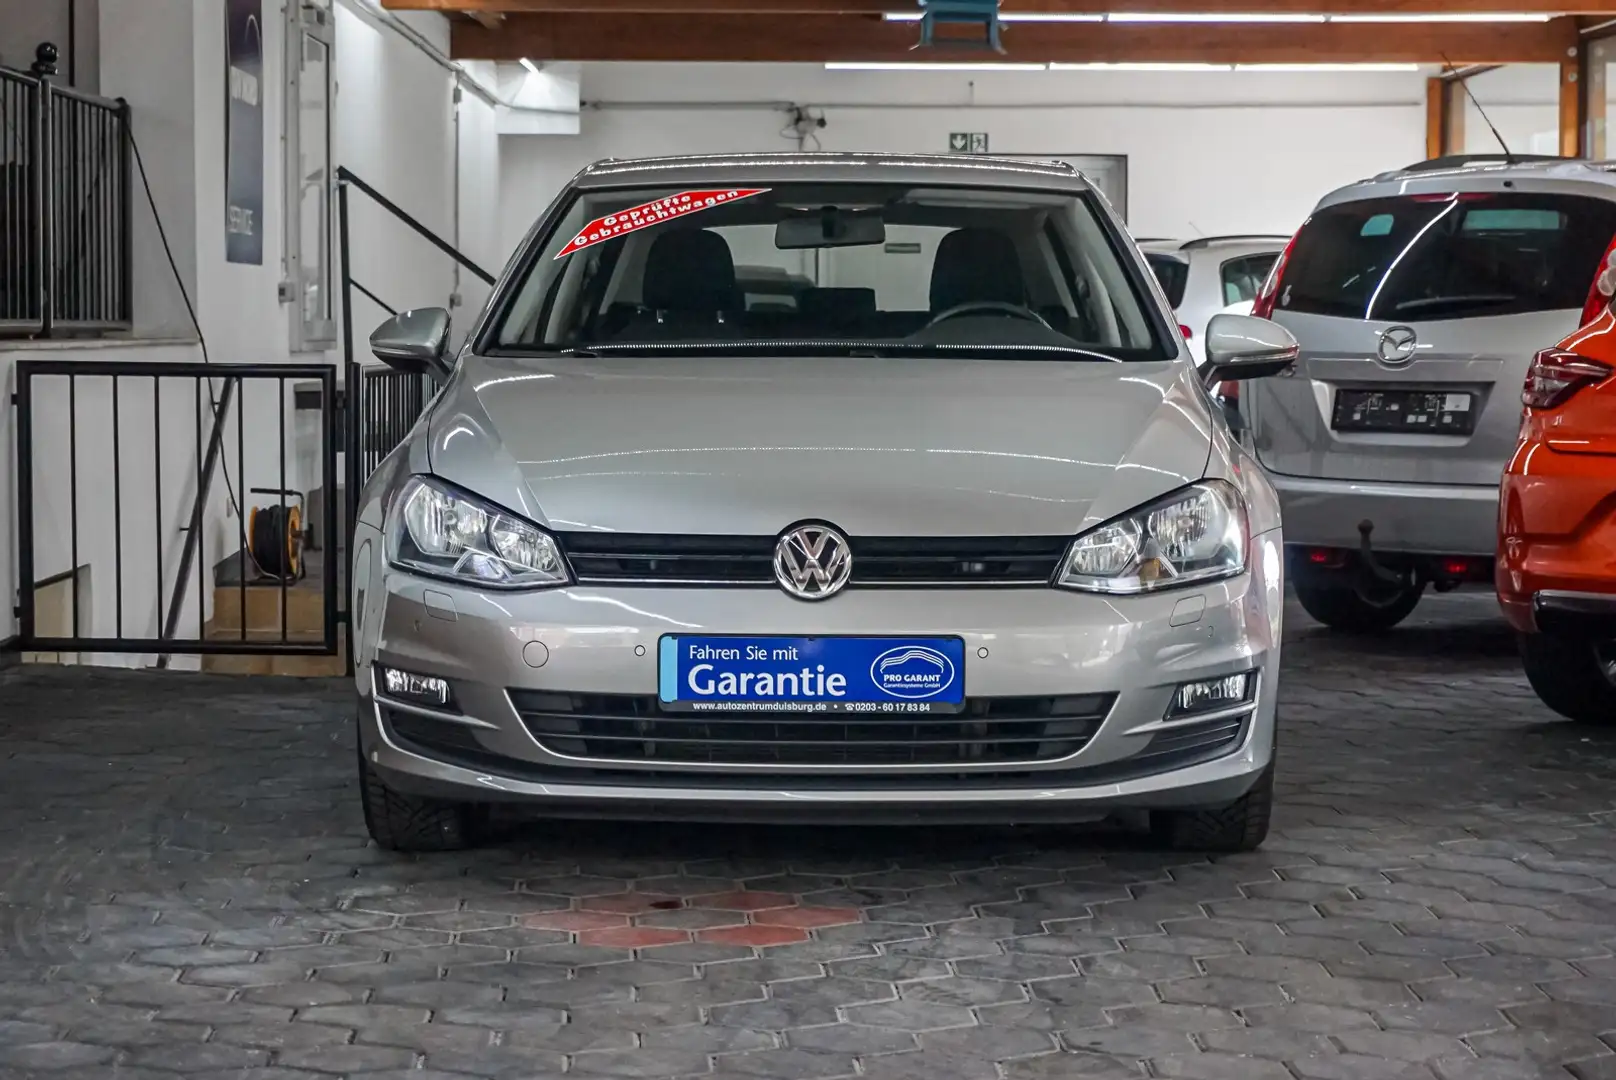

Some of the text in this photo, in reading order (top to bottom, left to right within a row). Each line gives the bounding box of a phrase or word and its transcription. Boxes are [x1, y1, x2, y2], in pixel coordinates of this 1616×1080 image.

[573, 190, 739, 246] Gebrauchtwagen
[603, 194, 691, 226] Geprüfte
[689, 645, 799, 661] Fahren Sie mit
[687, 663, 847, 697] Garantie
[883, 674, 941, 682] PRO GARANT
[692, 702, 827, 713] www.autozentrumduisburg.de
